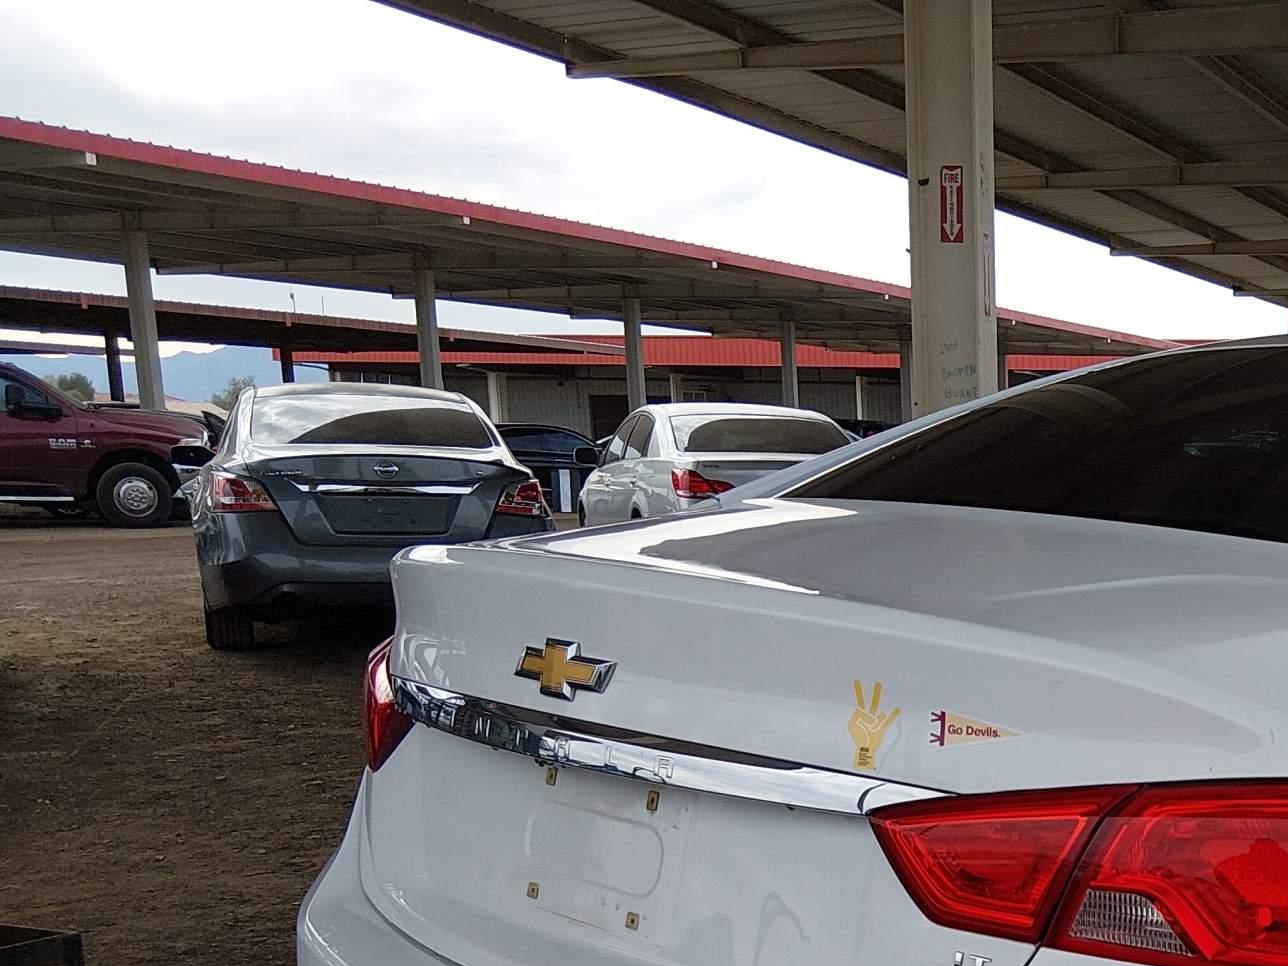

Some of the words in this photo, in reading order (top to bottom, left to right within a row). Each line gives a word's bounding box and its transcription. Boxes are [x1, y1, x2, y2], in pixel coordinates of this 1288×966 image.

[944, 173, 960, 184] FIRE
[947, 724, 963, 735] Go
[966, 726, 1001, 738] Devils.
